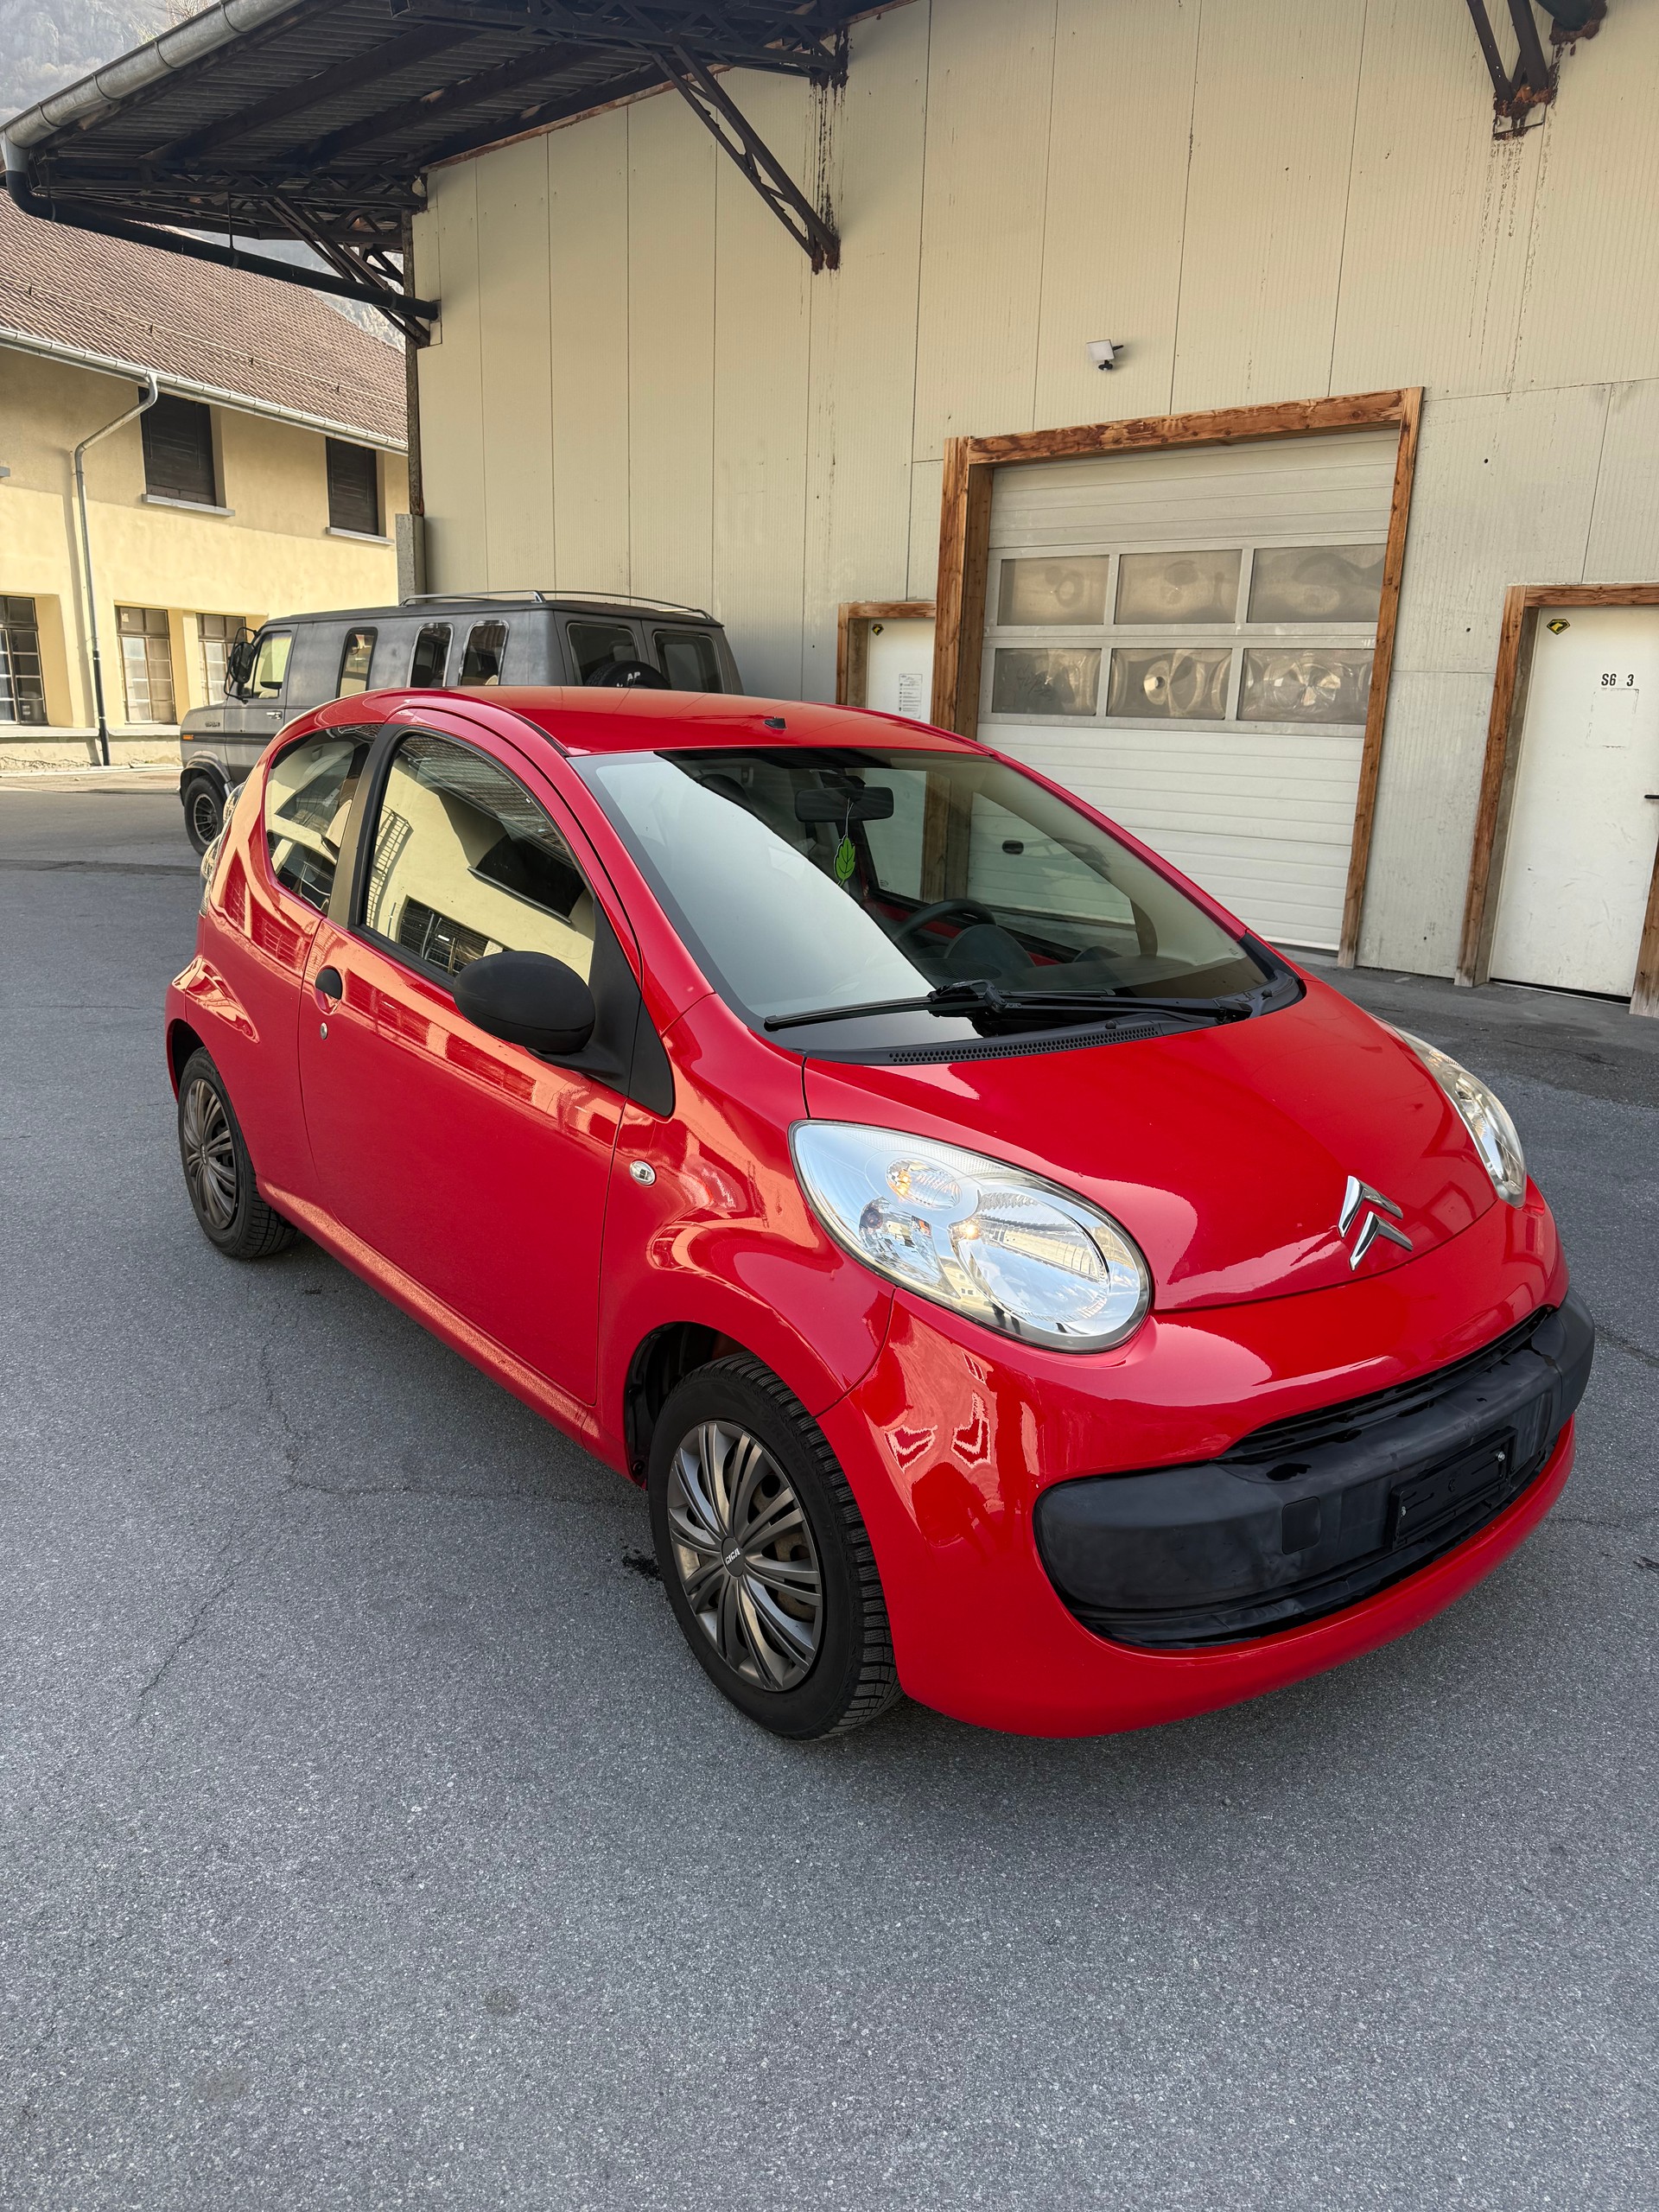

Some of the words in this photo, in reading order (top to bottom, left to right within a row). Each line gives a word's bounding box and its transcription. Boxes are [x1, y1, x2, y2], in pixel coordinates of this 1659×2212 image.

[1601, 673, 1617, 686] S6
[1626, 674, 1635, 686] 3
[725, 1548, 741, 1565] GIGA
